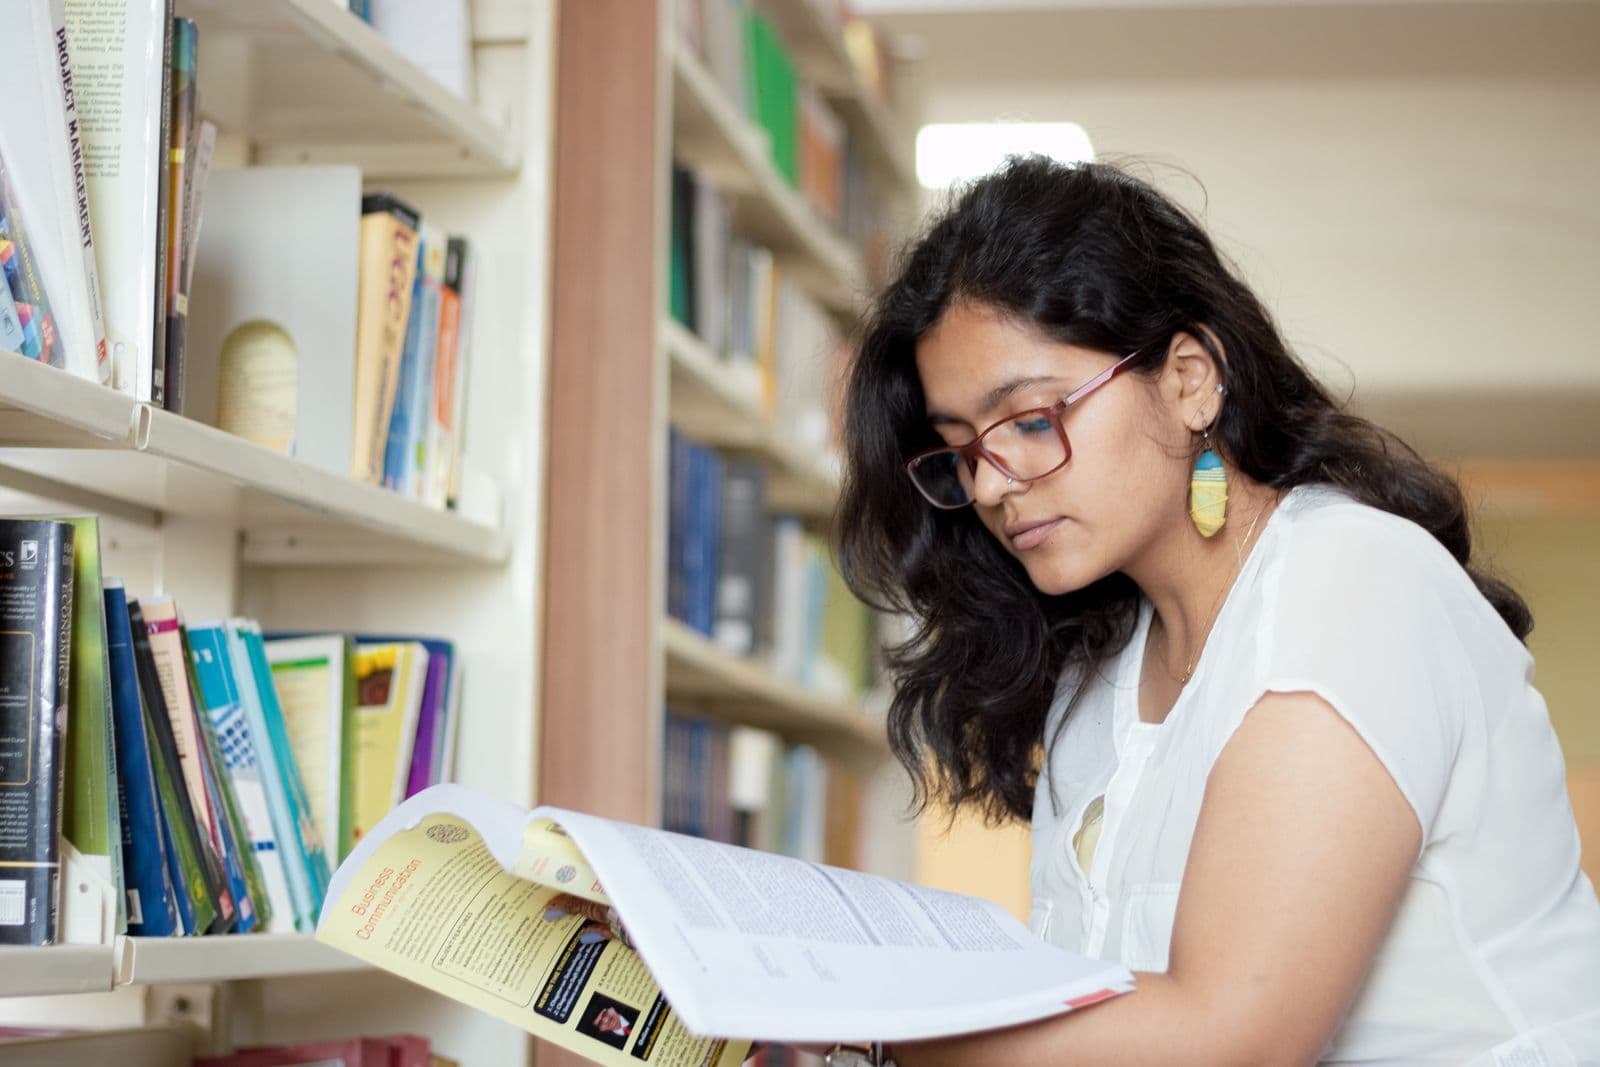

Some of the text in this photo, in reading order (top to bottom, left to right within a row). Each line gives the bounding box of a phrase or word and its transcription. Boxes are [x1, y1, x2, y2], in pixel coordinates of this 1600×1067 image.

[56, 27, 75, 112] PROJECT
[68, 119, 93, 249] MANAGEMENT
[58, 583, 69, 687] ECONOMICS
[352, 867, 394, 916] Business
[355, 857, 422, 941] Communication
